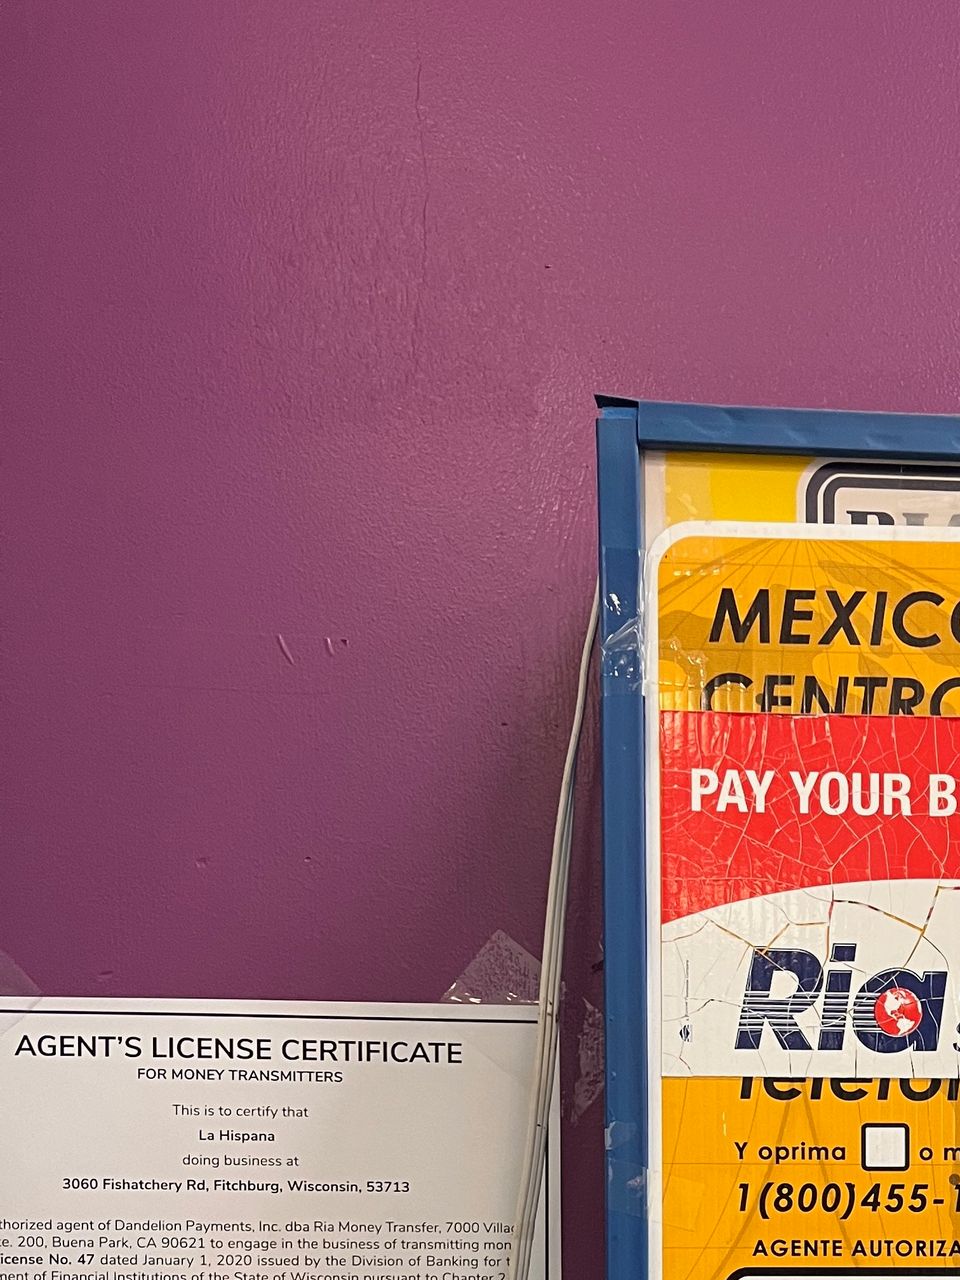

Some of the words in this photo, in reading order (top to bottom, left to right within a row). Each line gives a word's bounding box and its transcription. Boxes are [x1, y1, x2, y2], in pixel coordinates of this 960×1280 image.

[690, 768, 775, 813] PAY
[788, 770, 913, 817] YOUR
[734, 943, 948, 1053] Ria
[15, 1035, 141, 1057] AGENT’S
[153, 1037, 271, 1060] LICENSE
[282, 1040, 462, 1063] CERTIFICATE
[138, 1068, 166, 1079] FOR
[172, 1069, 224, 1080] MONEY
[228, 1070, 342, 1082] TRANSMITTERS
[172, 1104, 200, 1116] This
[205, 1105, 214, 1116] is
[219, 1106, 231, 1116] to
[236, 1106, 278, 1119] certify
[282, 1106, 308, 1117] that
[200, 1130, 214, 1140] La
[220, 1130, 274, 1143] Hispana
[734, 1142, 749, 1161] Y
[758, 1141, 847, 1165] oprima
[919, 1145, 934, 1161] o
[183, 1154, 219, 1168] doing
[224, 1155, 282, 1166] business
[286, 1157, 299, 1166] at
[63, 1178, 98, 1189] 3060
[103, 1179, 182, 1192] Fishatchery
[187, 1180, 209, 1192] Rd,
[214, 1180, 282, 1193] Fitchburg,
[287, 1181, 361, 1193] Wisconsin,
[367, 1181, 409, 1192] 53713
[57, 1221, 94, 1233] agent
[98, 1220, 111, 1230] of
[115, 1220, 181, 1231] Dandelion
[186, 1220, 255, 1234] Payments,
[259, 1221, 281, 1232] Inc.
[285, 1221, 309, 1232] dba
[314, 1221, 334, 1232] Ria
[339, 1221, 382, 1235] Money
[385, 1221, 441, 1234] Transfer,
[446, 1222, 479, 1233] 7000
[18, 1236, 47, 1248] 200,
[52, 1236, 94, 1247] Buena
[99, 1237, 132, 1249] Park,
[137, 1237, 156, 1248] CA
[162, 1237, 205, 1248] 90621
[210, 1239, 223, 1248] to
[228, 1241, 277, 1251] engage
[282, 1238, 292, 1249] in
[297, 1238, 318, 1249] the
[323, 1238, 380, 1249] business
[384, 1239, 397, 1249] of
[401, 1239, 479, 1252] transmitting
[752, 1239, 843, 1257] AGENTE
